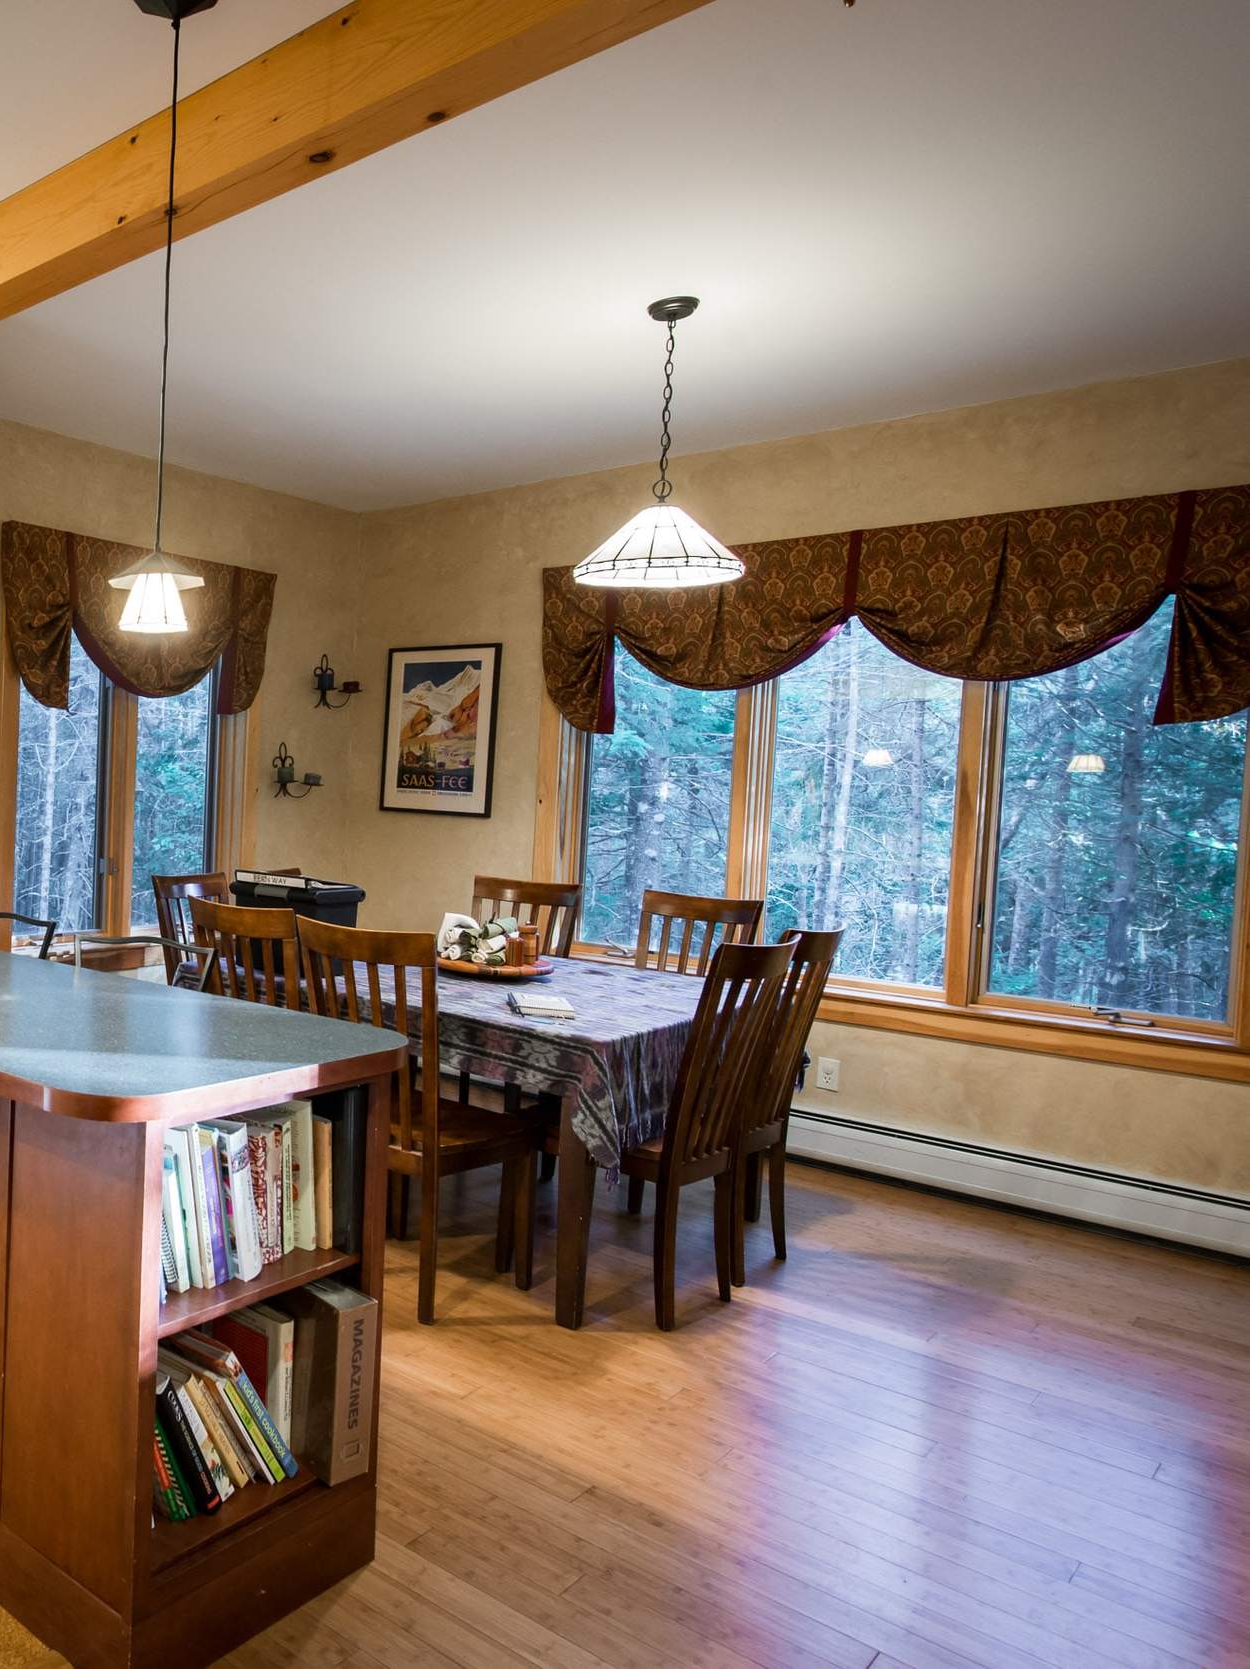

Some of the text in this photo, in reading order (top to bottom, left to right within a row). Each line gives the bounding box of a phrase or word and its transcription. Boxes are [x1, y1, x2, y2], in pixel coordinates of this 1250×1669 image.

[401, 774, 468, 788] SAAS-FEE
[348, 1318, 364, 1430] MAGAZINES
[261, 1418, 286, 1458] cookbook
